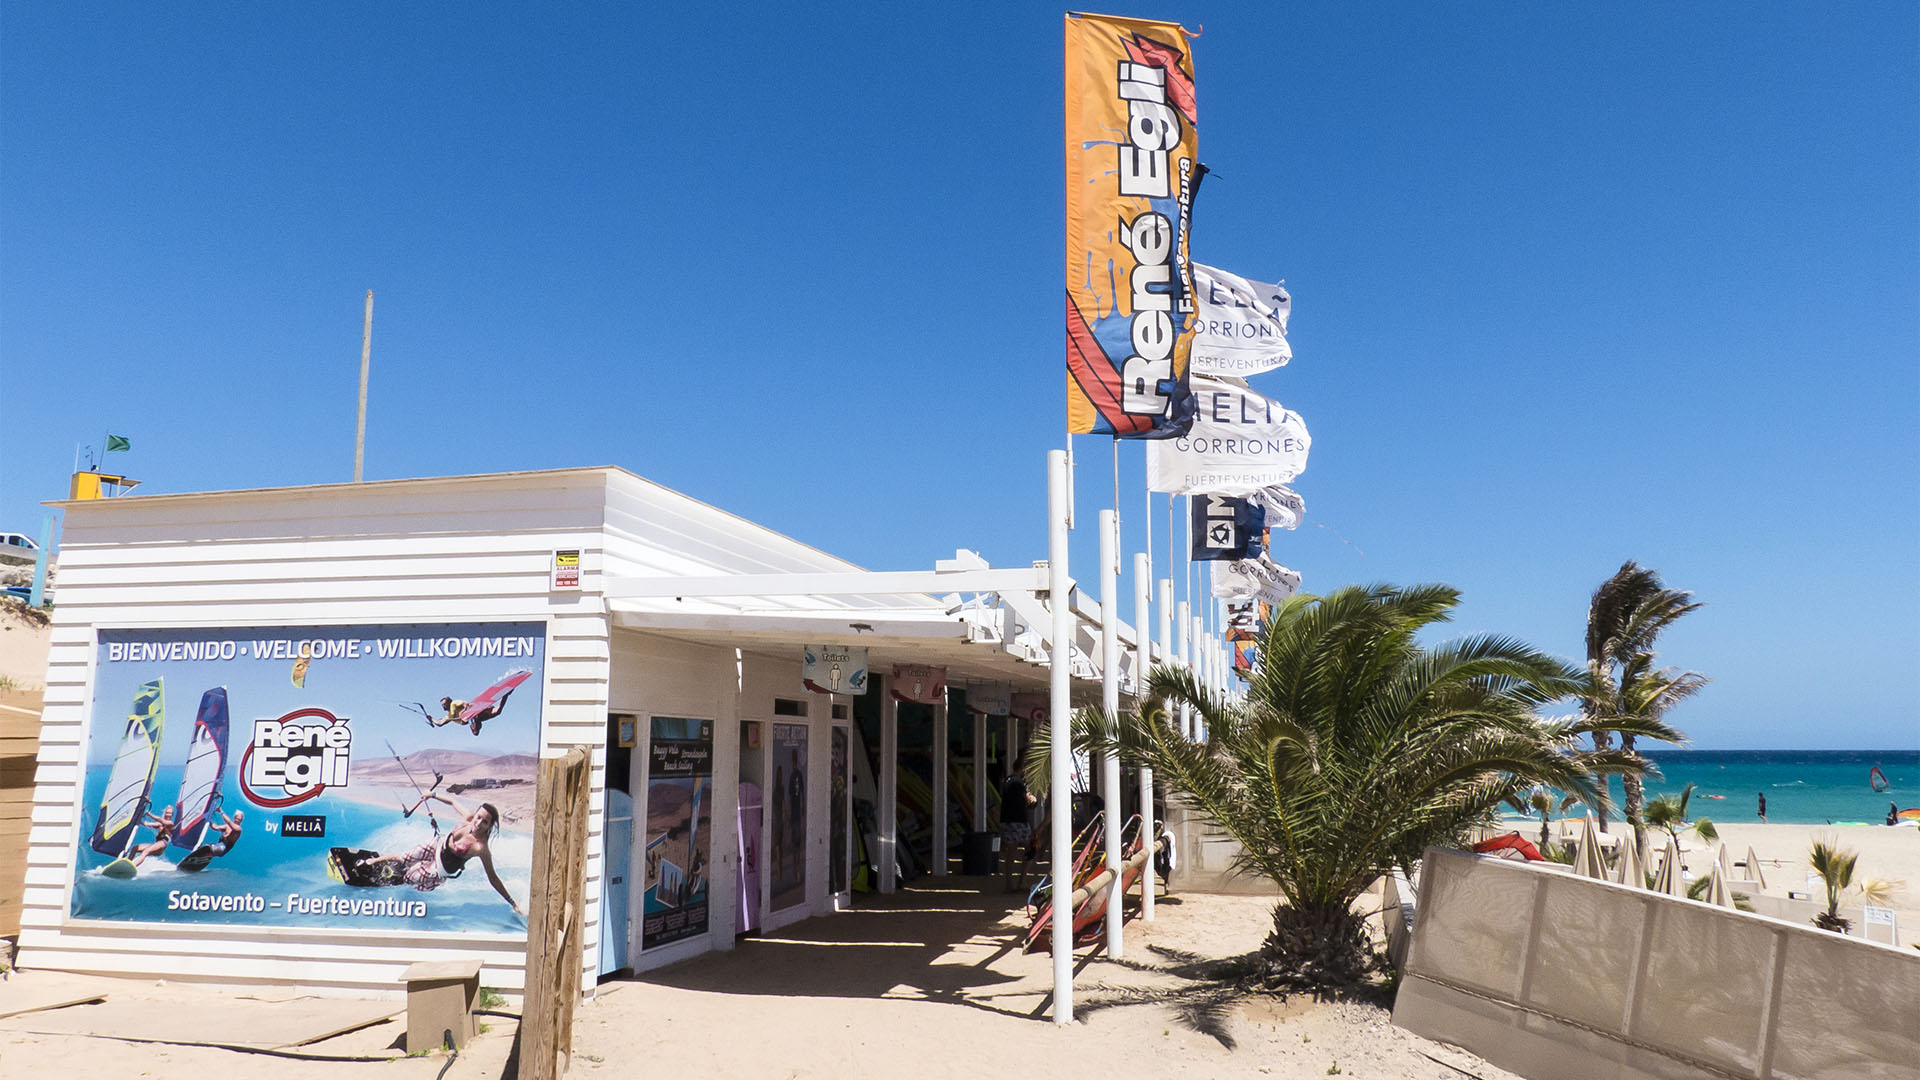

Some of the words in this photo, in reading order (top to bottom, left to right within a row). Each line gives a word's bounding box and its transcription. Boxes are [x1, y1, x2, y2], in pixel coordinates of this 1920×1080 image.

[1119, 60, 1181, 199] Egli
[1119, 212, 1174, 415] René
[1175, 437, 1305, 455] GORRIONES
[109, 641, 236, 661] BIENVENIDO
[252, 639, 361, 659] WELCOME
[377, 637, 535, 658] WILLKOMMEN
[822, 653, 850, 662] Toilets
[254, 719, 351, 748] René
[250, 747, 349, 797] Egli
[265, 820, 279, 834] by
[168, 890, 265, 912] Sotavento
[287, 893, 427, 917] Fuerteventura
